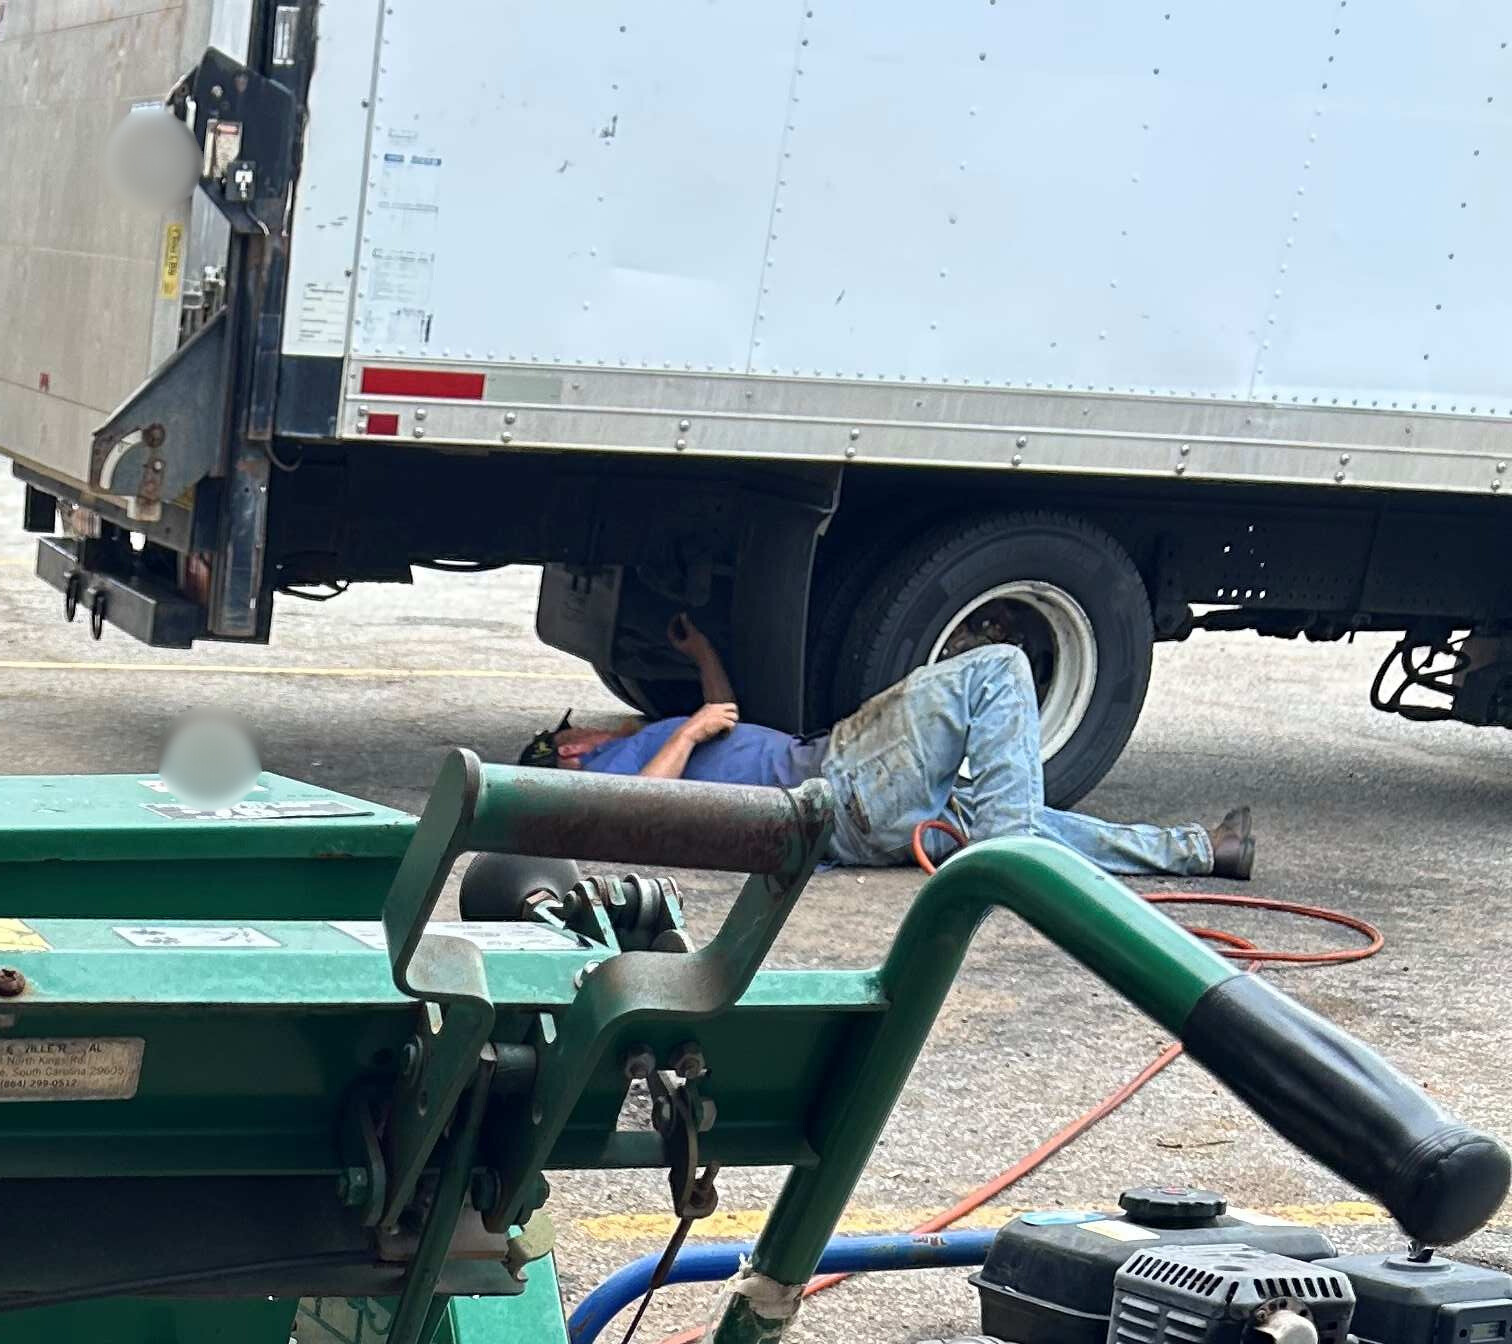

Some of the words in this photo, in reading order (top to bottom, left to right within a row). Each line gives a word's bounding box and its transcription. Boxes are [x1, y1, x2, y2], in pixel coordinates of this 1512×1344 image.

[12, 1066, 42, 1078] South
[45, 1065, 87, 1077] Carolina
[0, 1079, 27, 1090] (864)
